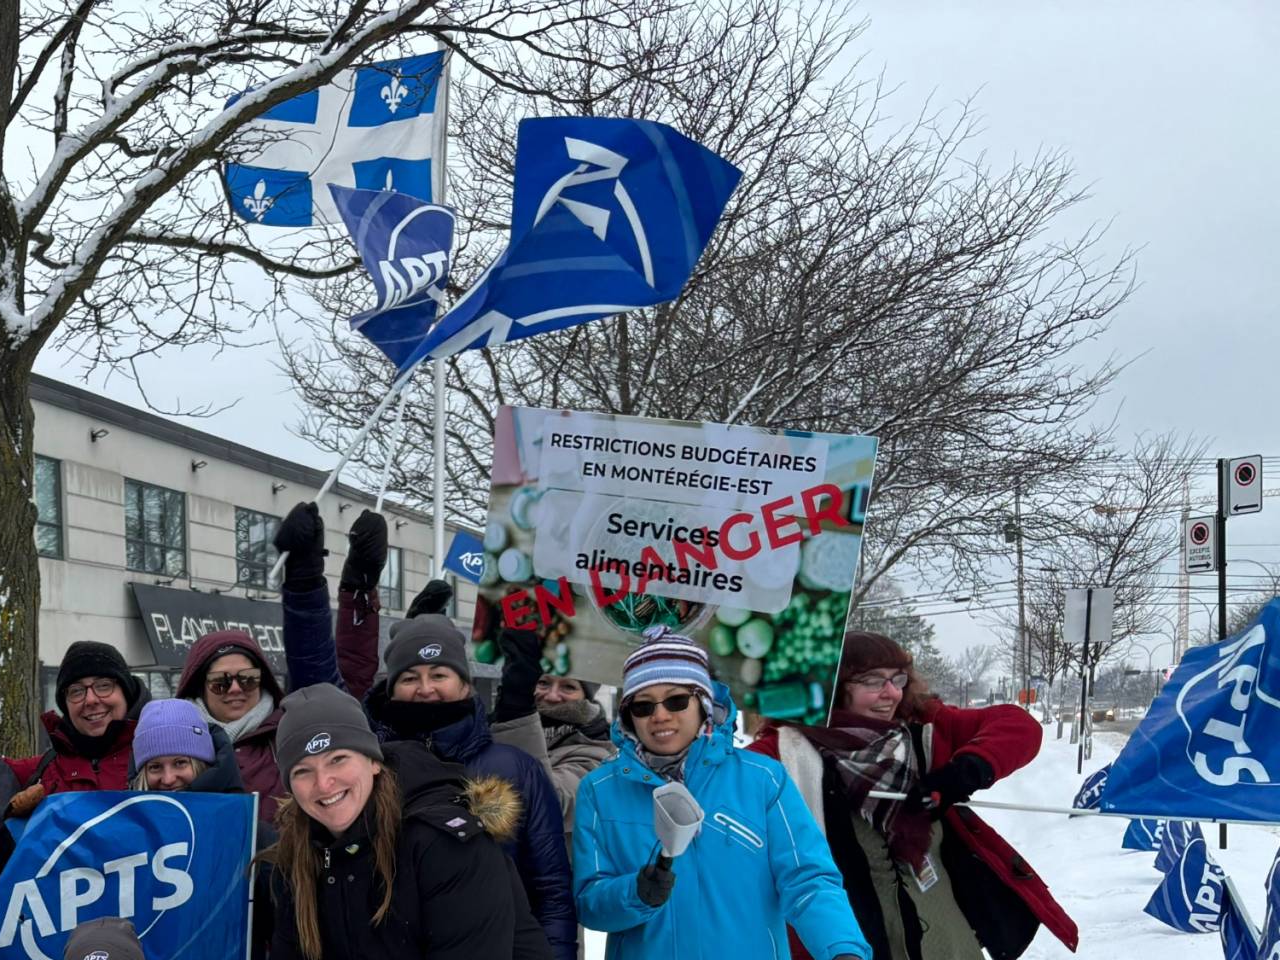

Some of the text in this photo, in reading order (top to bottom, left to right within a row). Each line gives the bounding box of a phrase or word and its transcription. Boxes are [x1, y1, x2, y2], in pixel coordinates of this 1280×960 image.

[551, 434, 817, 472] RESTRICTIONS BUDGÉTAIRES
[583, 463, 772, 495] EN MONTÉRÉGIE-EST
[607, 513, 720, 547] Services
[502, 483, 849, 631] EN DANGER
[575, 550, 743, 592] alimentaires
[305, 738, 330, 751] APTS
